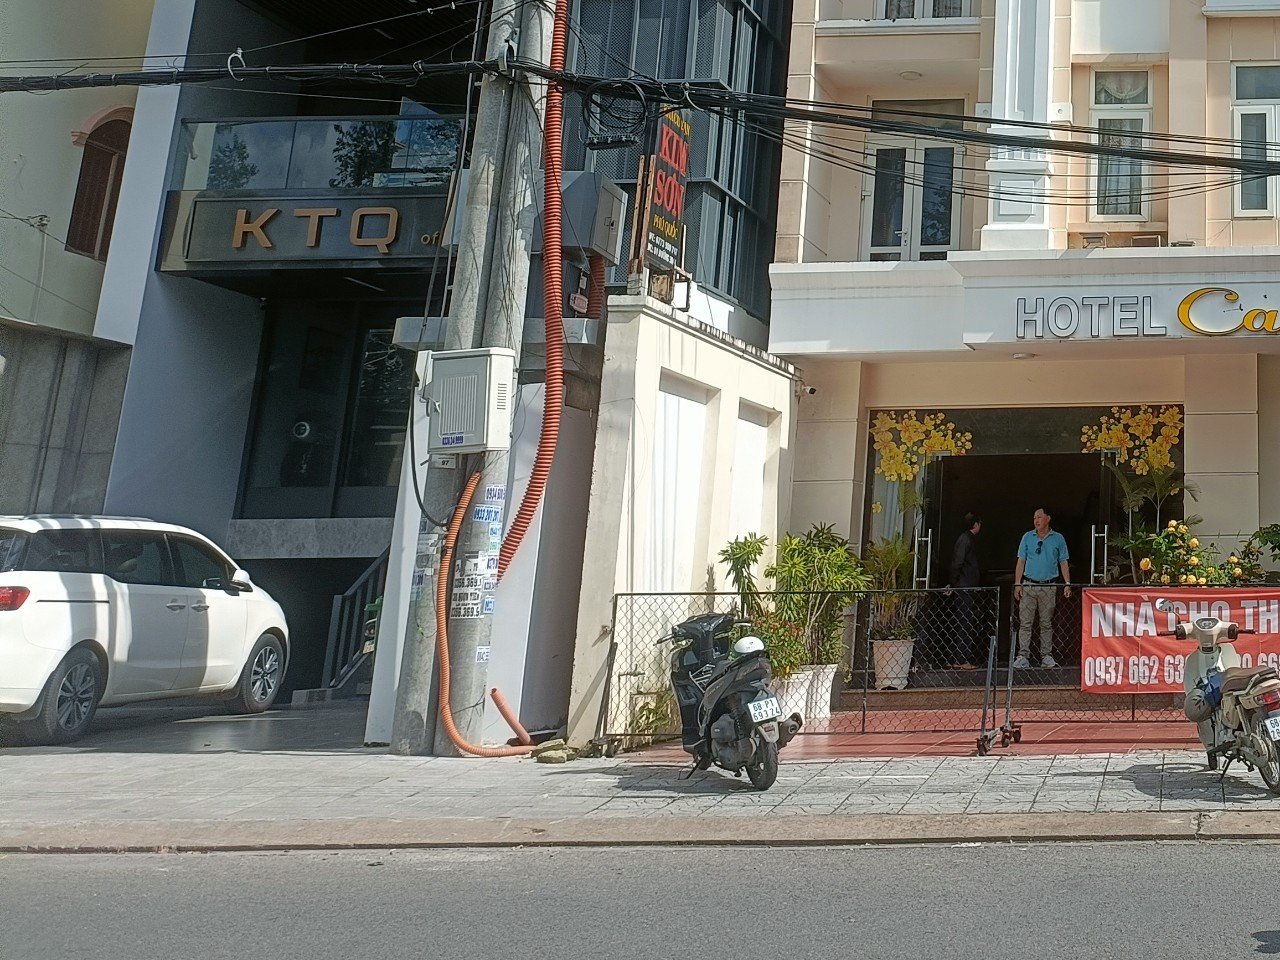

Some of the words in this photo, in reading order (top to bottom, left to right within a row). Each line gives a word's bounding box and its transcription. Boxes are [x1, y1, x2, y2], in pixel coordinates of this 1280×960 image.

[659, 123, 689, 177] KIM
[653, 168, 685, 221] SƠN
[231, 206, 399, 253] KTQ
[1015, 295, 1167, 338] HOTEL
[1091, 595, 1157, 638] NHÀ
[1085, 656, 1124, 687] 0937
[1128, 655, 1159, 685] 662
[1164, 654, 1188, 685] 63
